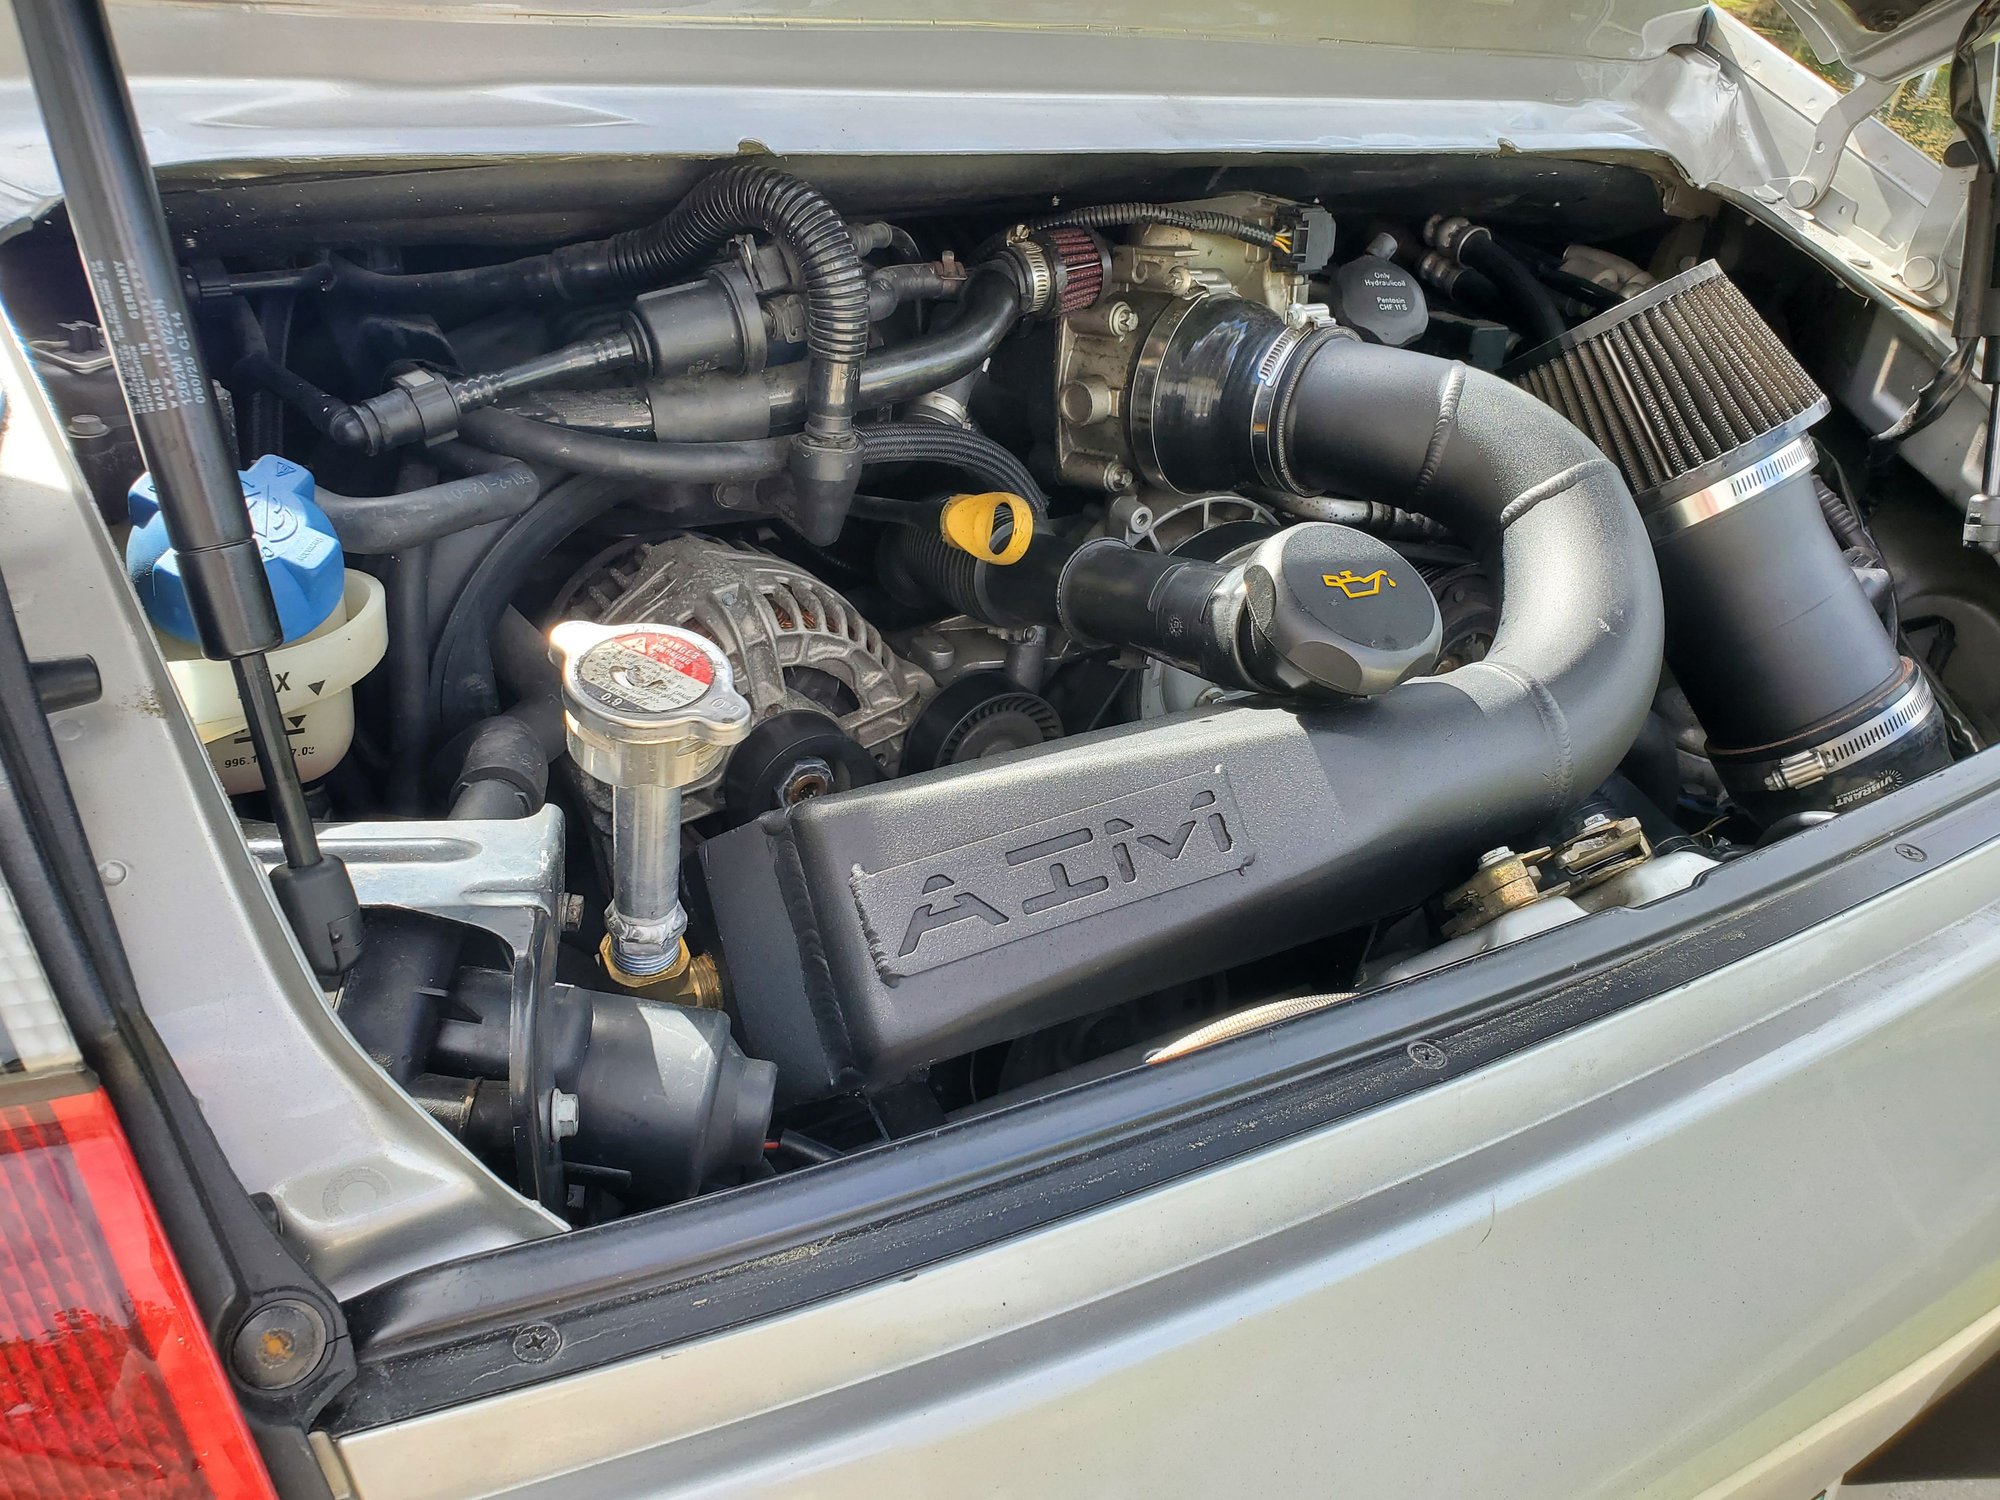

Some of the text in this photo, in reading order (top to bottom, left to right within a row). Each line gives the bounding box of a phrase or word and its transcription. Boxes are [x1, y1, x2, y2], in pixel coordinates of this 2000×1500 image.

[1374, 271, 1391, 280] Only
[1376, 296, 1406, 304] Pentosin
[1379, 303, 1394, 311] CHF
[152, 297, 175, 345] 0220N
[112, 259, 167, 411] MADE IN GERMANY
[600, 692, 624, 707] 0.9
[1835, 775, 1894, 807] VIBRANT
